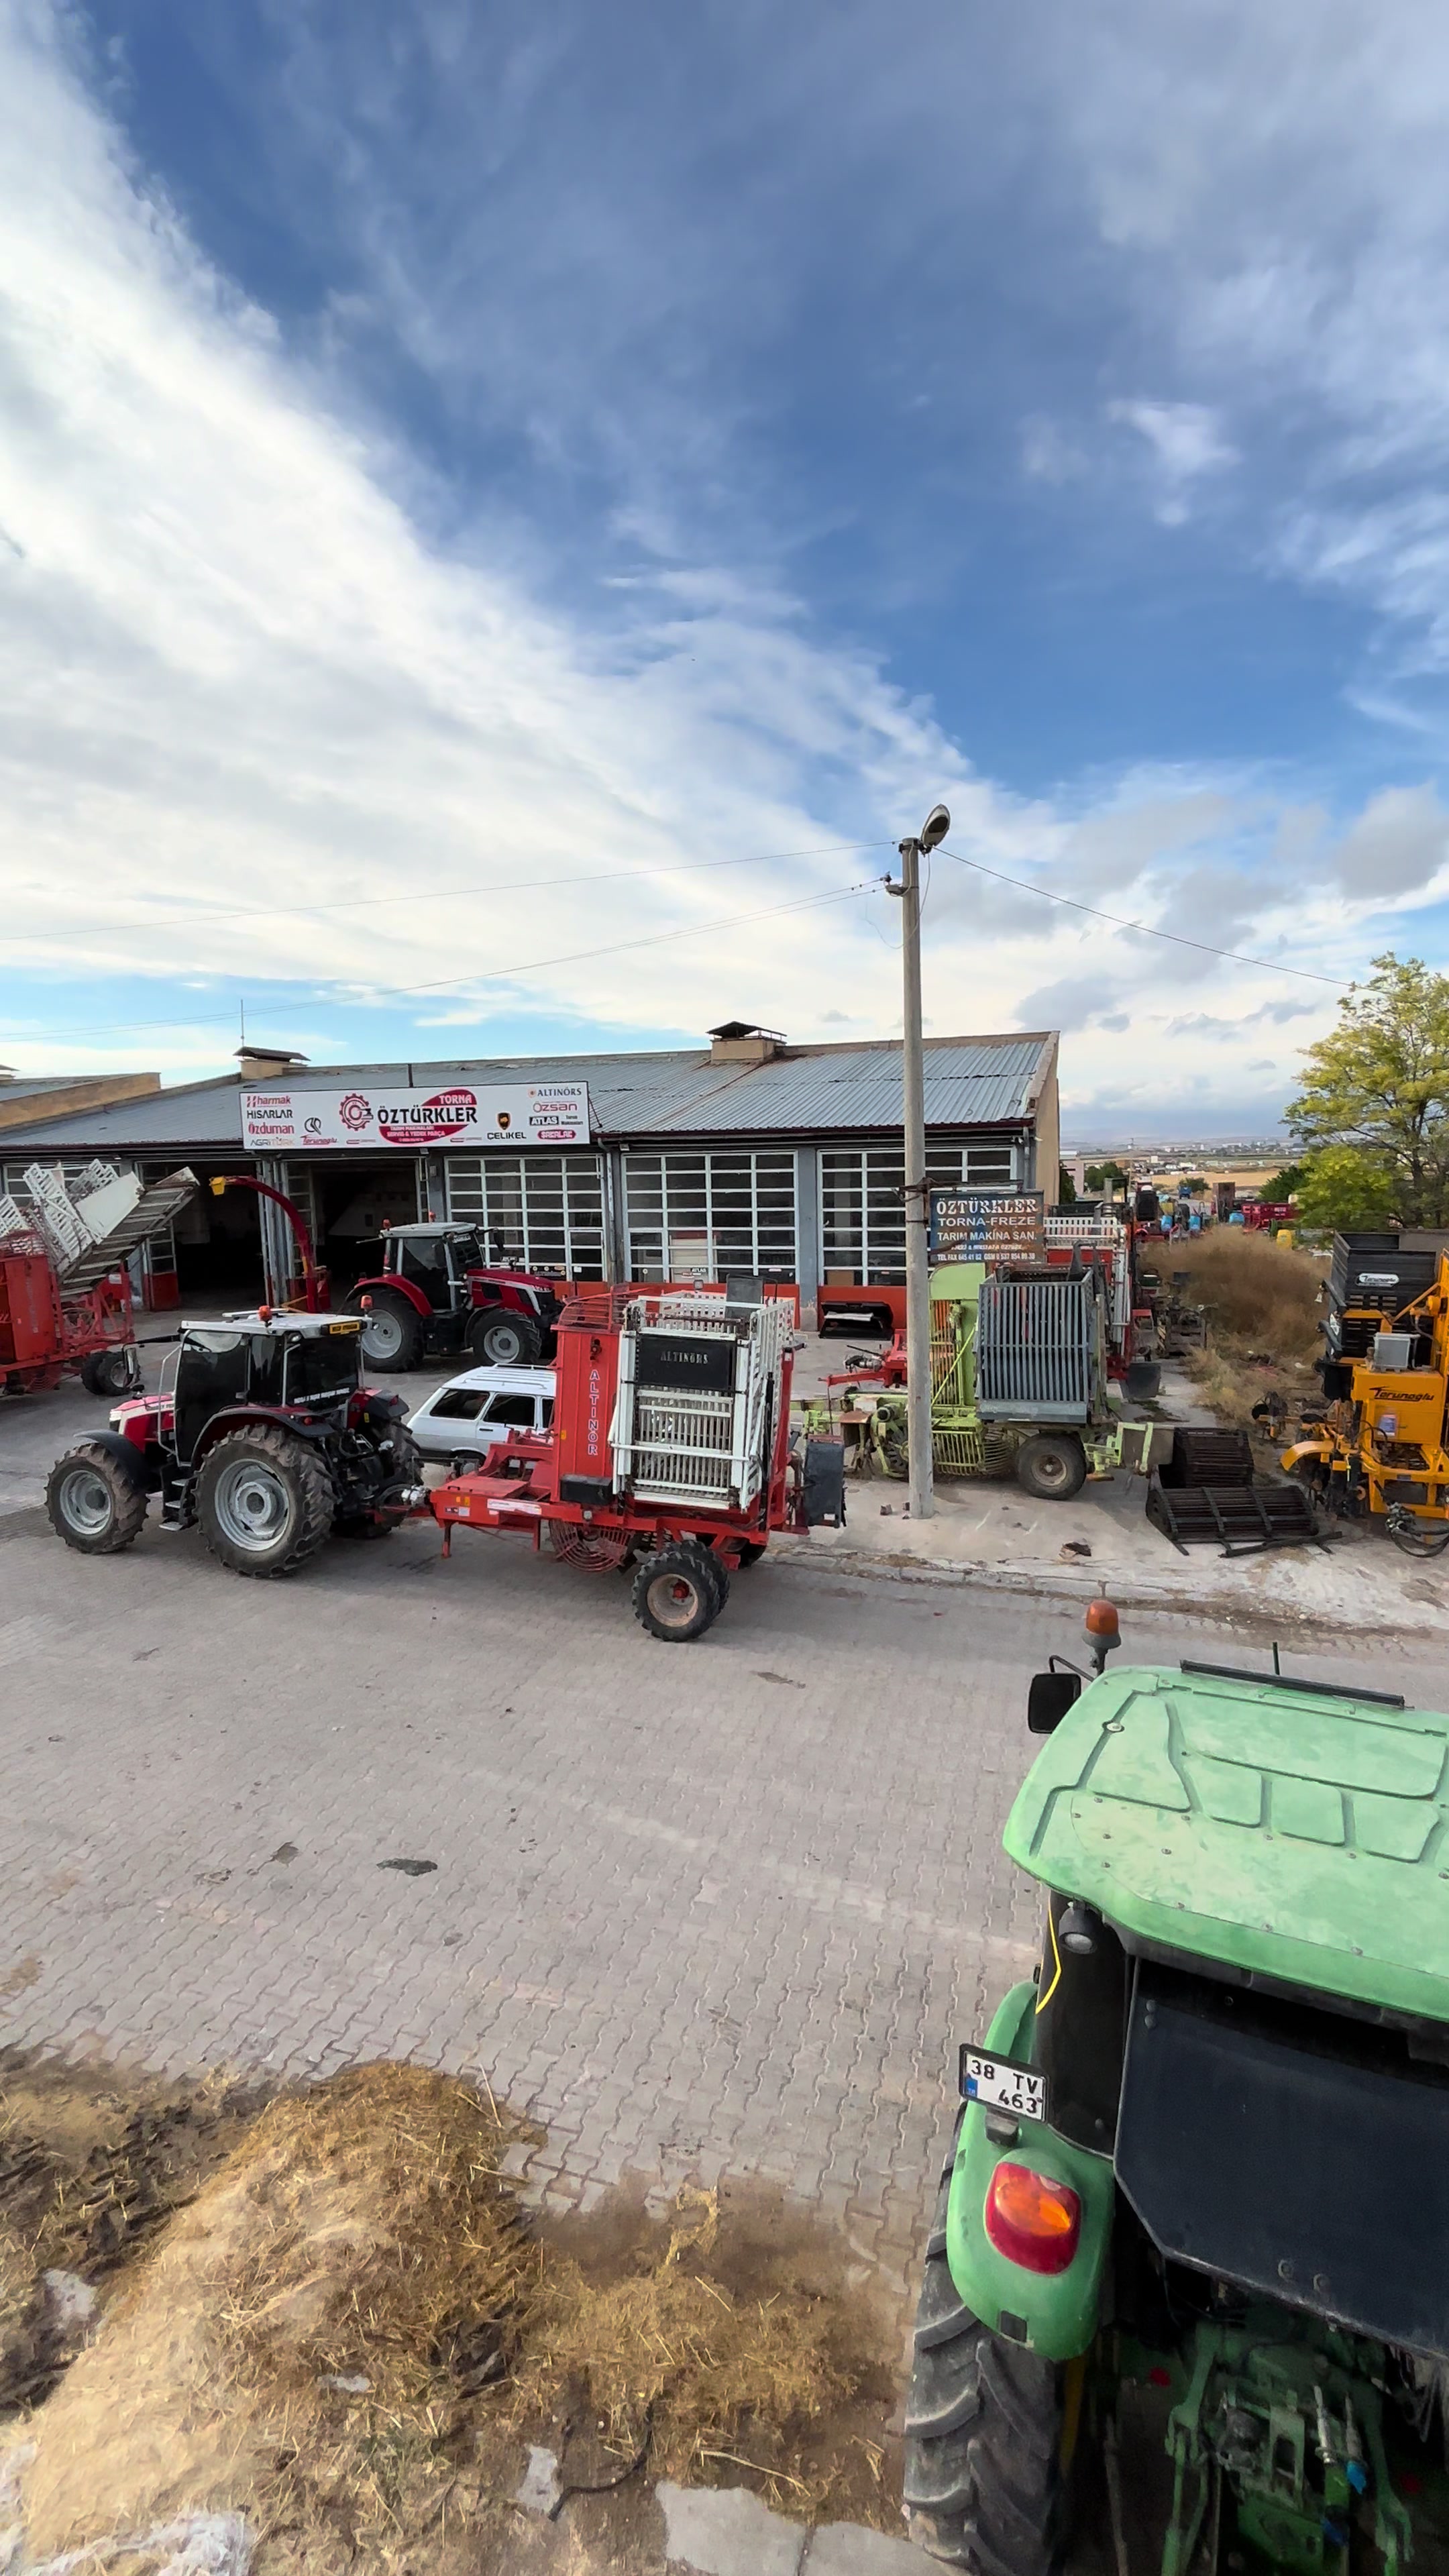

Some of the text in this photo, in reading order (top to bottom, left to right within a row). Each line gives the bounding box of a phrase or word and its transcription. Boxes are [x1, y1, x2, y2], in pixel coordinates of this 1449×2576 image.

[537, 1087, 582, 1096] ALTINÖRS
[257, 1095, 291, 1104] harmak
[439, 1094, 472, 1104] TORNA
[377, 1106, 478, 1124] ÖZTÜRKLER
[531, 1117, 557, 1125] ATLAS
[248, 1122, 294, 1134] Özduman
[936, 1197, 1038, 1215] ÖZTÜRKLER
[938, 1216, 1036, 1227] TORNA-FREZE
[938, 1232, 967, 1241] TARIM
[971, 2059, 1038, 2094] 38 TV
[999, 2089, 1038, 2113] 463
